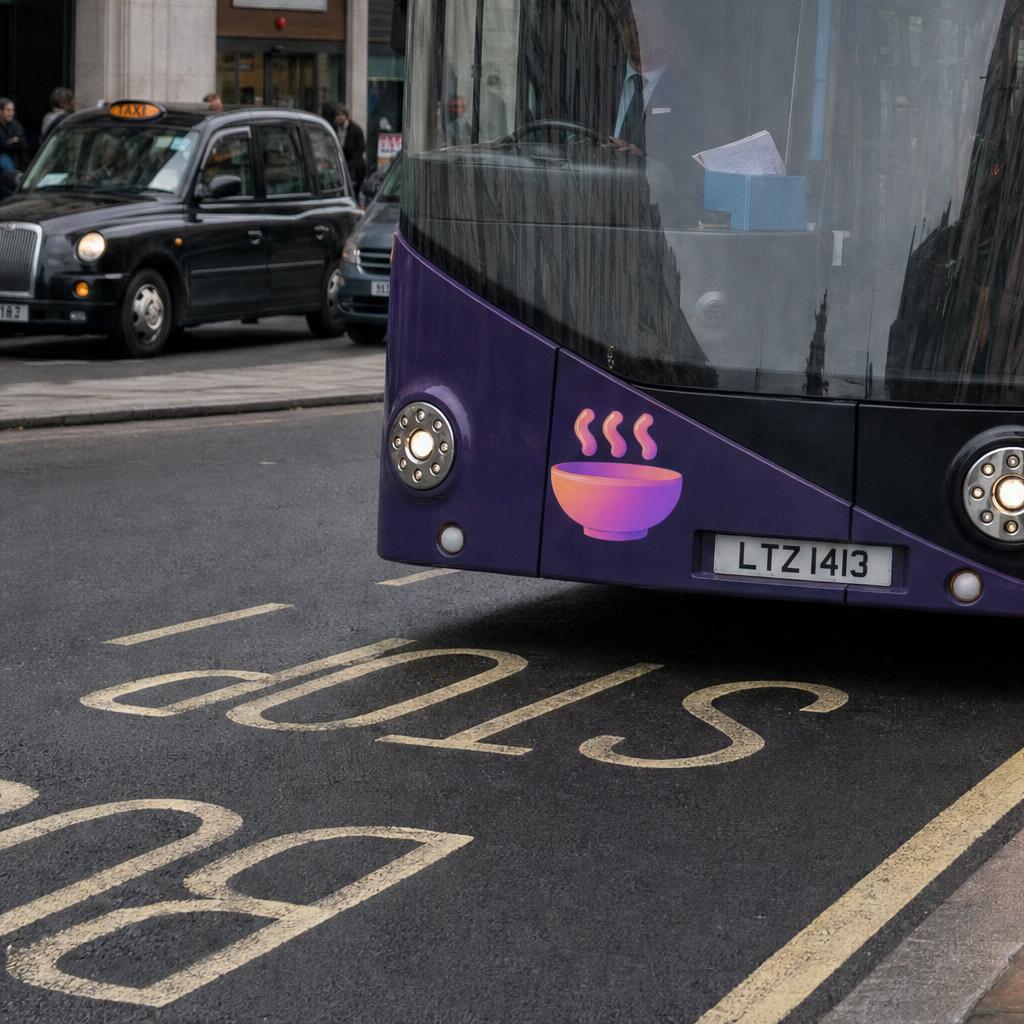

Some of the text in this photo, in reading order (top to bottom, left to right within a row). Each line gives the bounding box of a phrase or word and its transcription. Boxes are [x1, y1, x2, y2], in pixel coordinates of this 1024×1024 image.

[119, 104, 146, 116] TAXI
[739, 542, 869, 578] LTZ 1413
[79, 636, 849, 769] STOP
[0, 781, 474, 1008] BU
